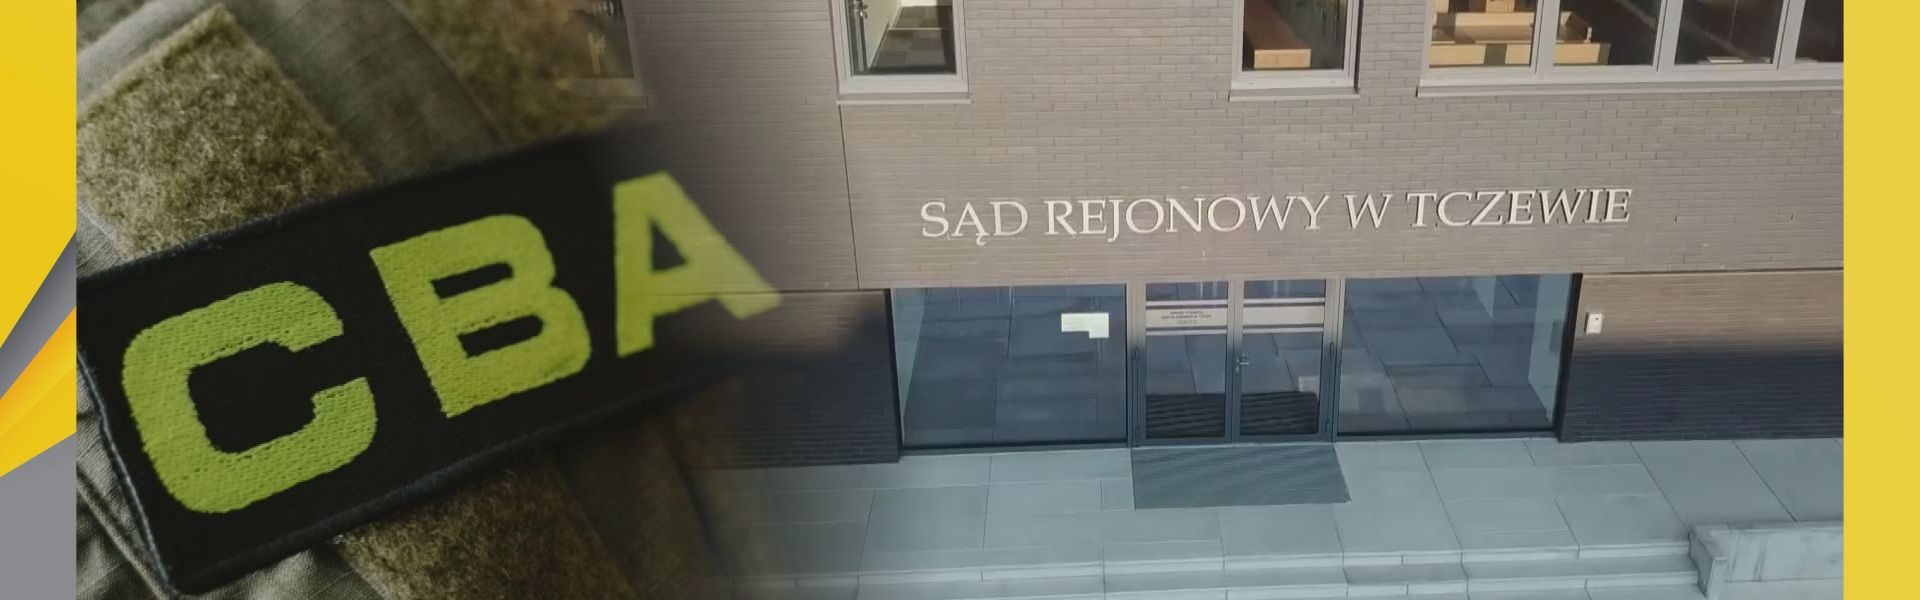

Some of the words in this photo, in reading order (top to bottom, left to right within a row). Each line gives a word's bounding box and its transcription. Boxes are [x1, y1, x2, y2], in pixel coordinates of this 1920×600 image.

[919, 200, 1029, 247] SĄD
[1043, 194, 1329, 243] REJONOWY
[1343, 193, 1393, 230] W
[1405, 188, 1633, 228] TCZEWIE
[121, 171, 782, 515] CBA
